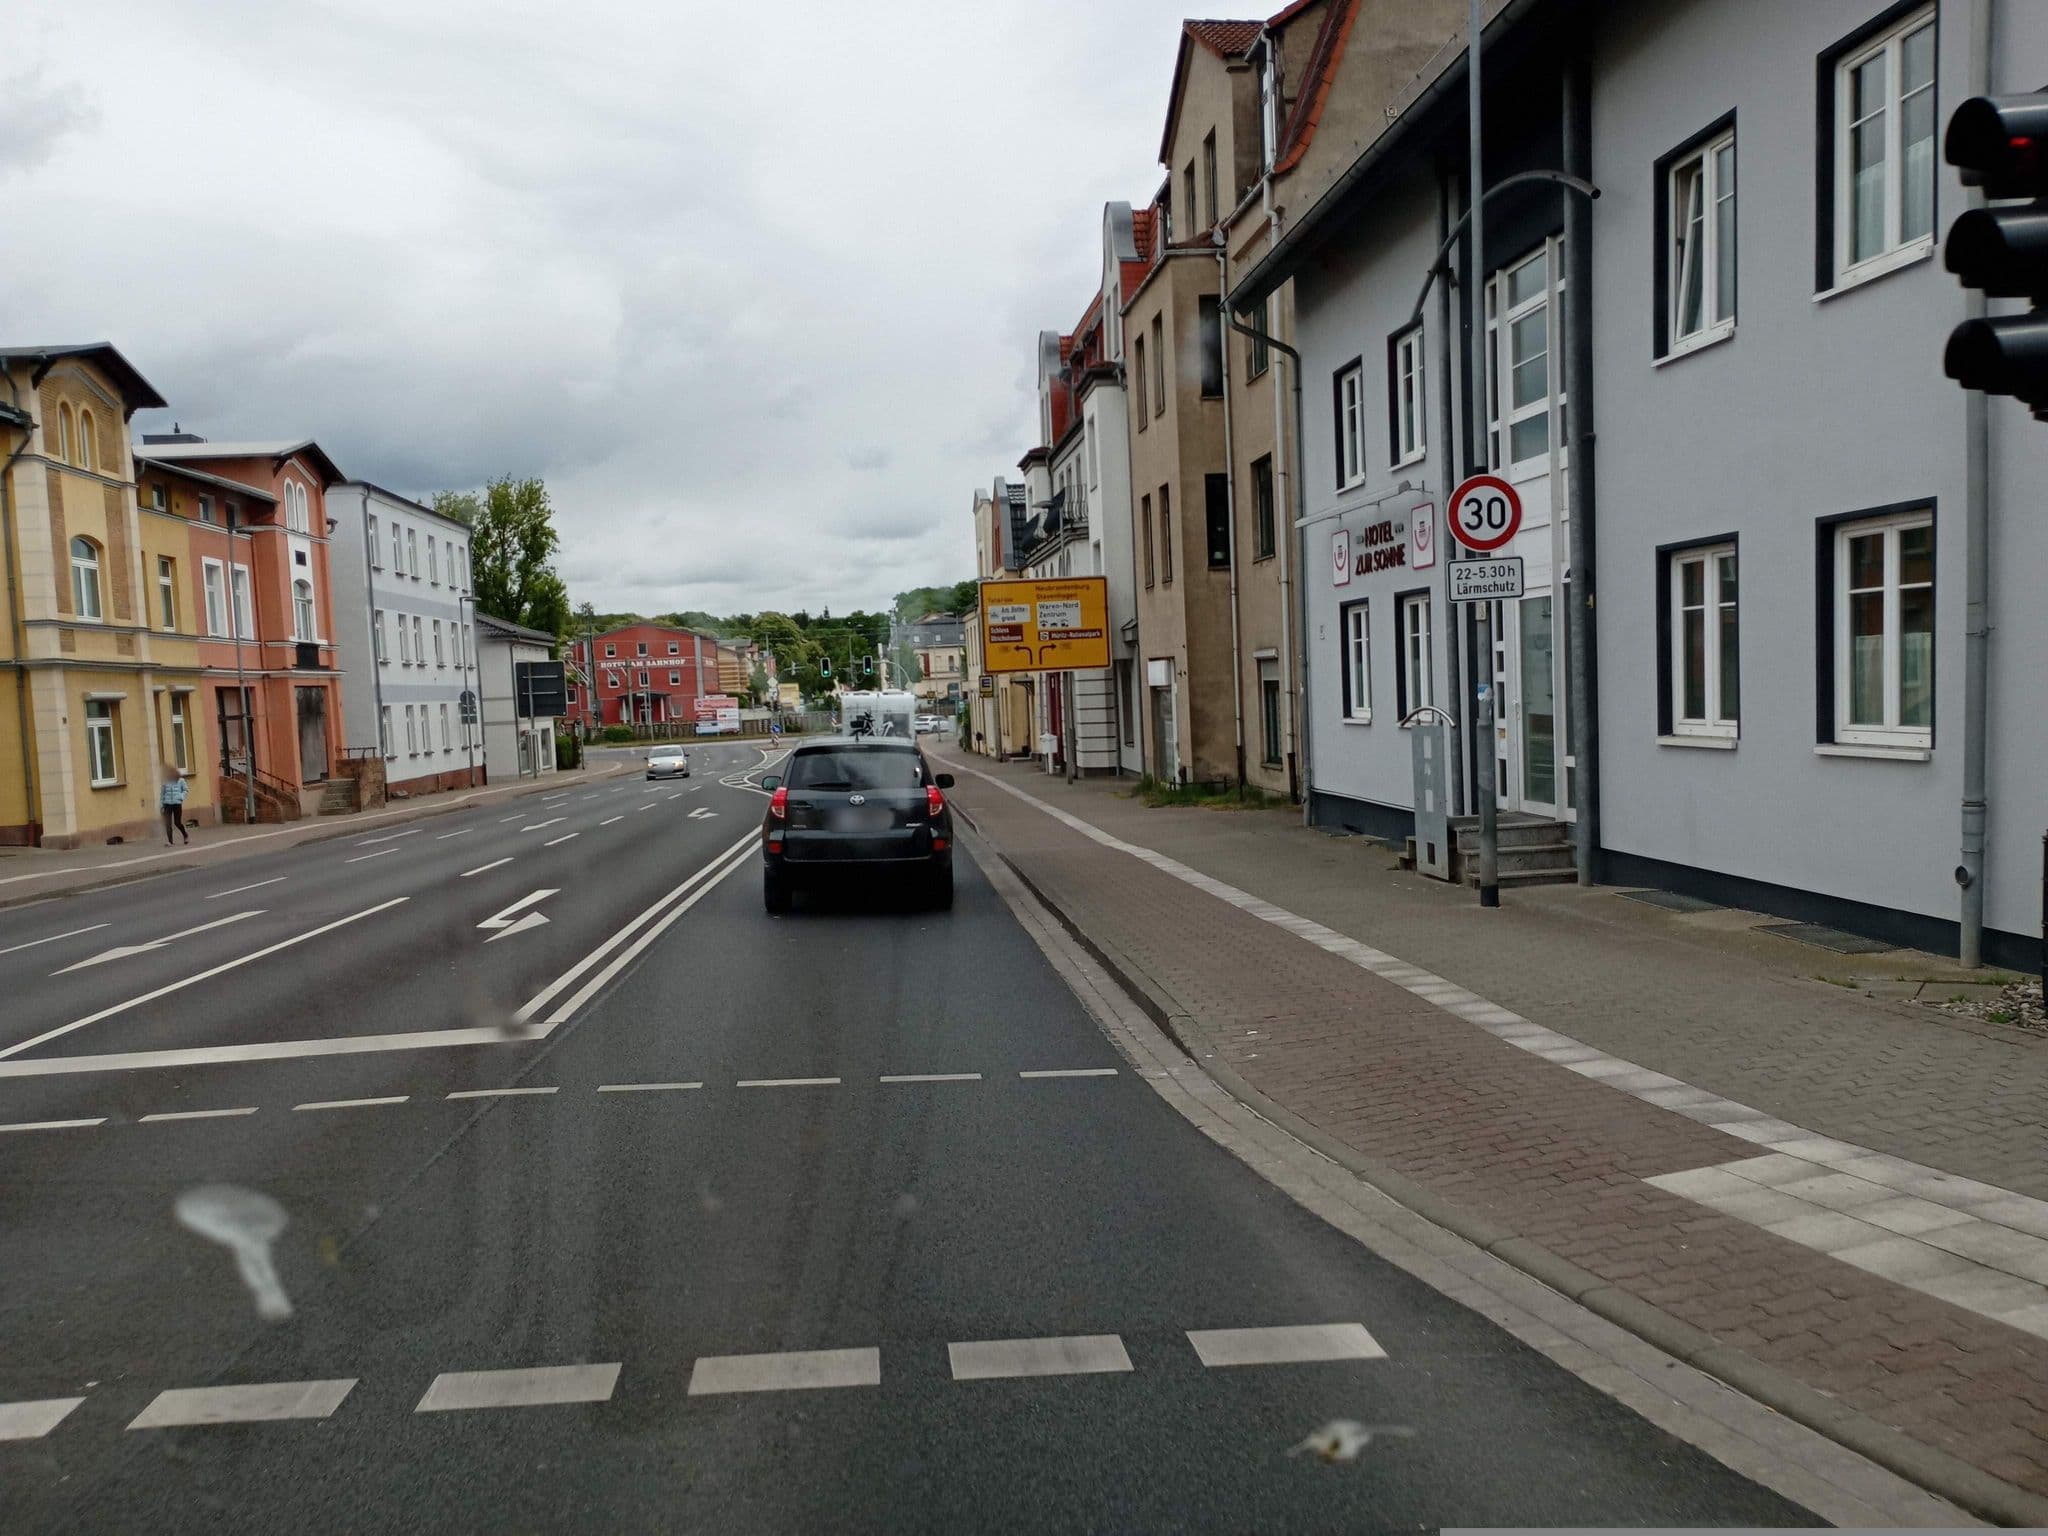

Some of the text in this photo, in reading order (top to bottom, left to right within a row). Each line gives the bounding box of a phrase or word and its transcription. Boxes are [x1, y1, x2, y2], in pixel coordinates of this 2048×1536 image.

[1463, 496, 1506, 531] 30
[1364, 520, 1394, 548] HOTEL
[1355, 543, 1406, 576] ZUR SONNE
[1456, 565, 1515, 580] 22-5.30 h
[1456, 580, 1516, 596] Lärmschutz
[1038, 602, 1079, 610] Waren-Nord
